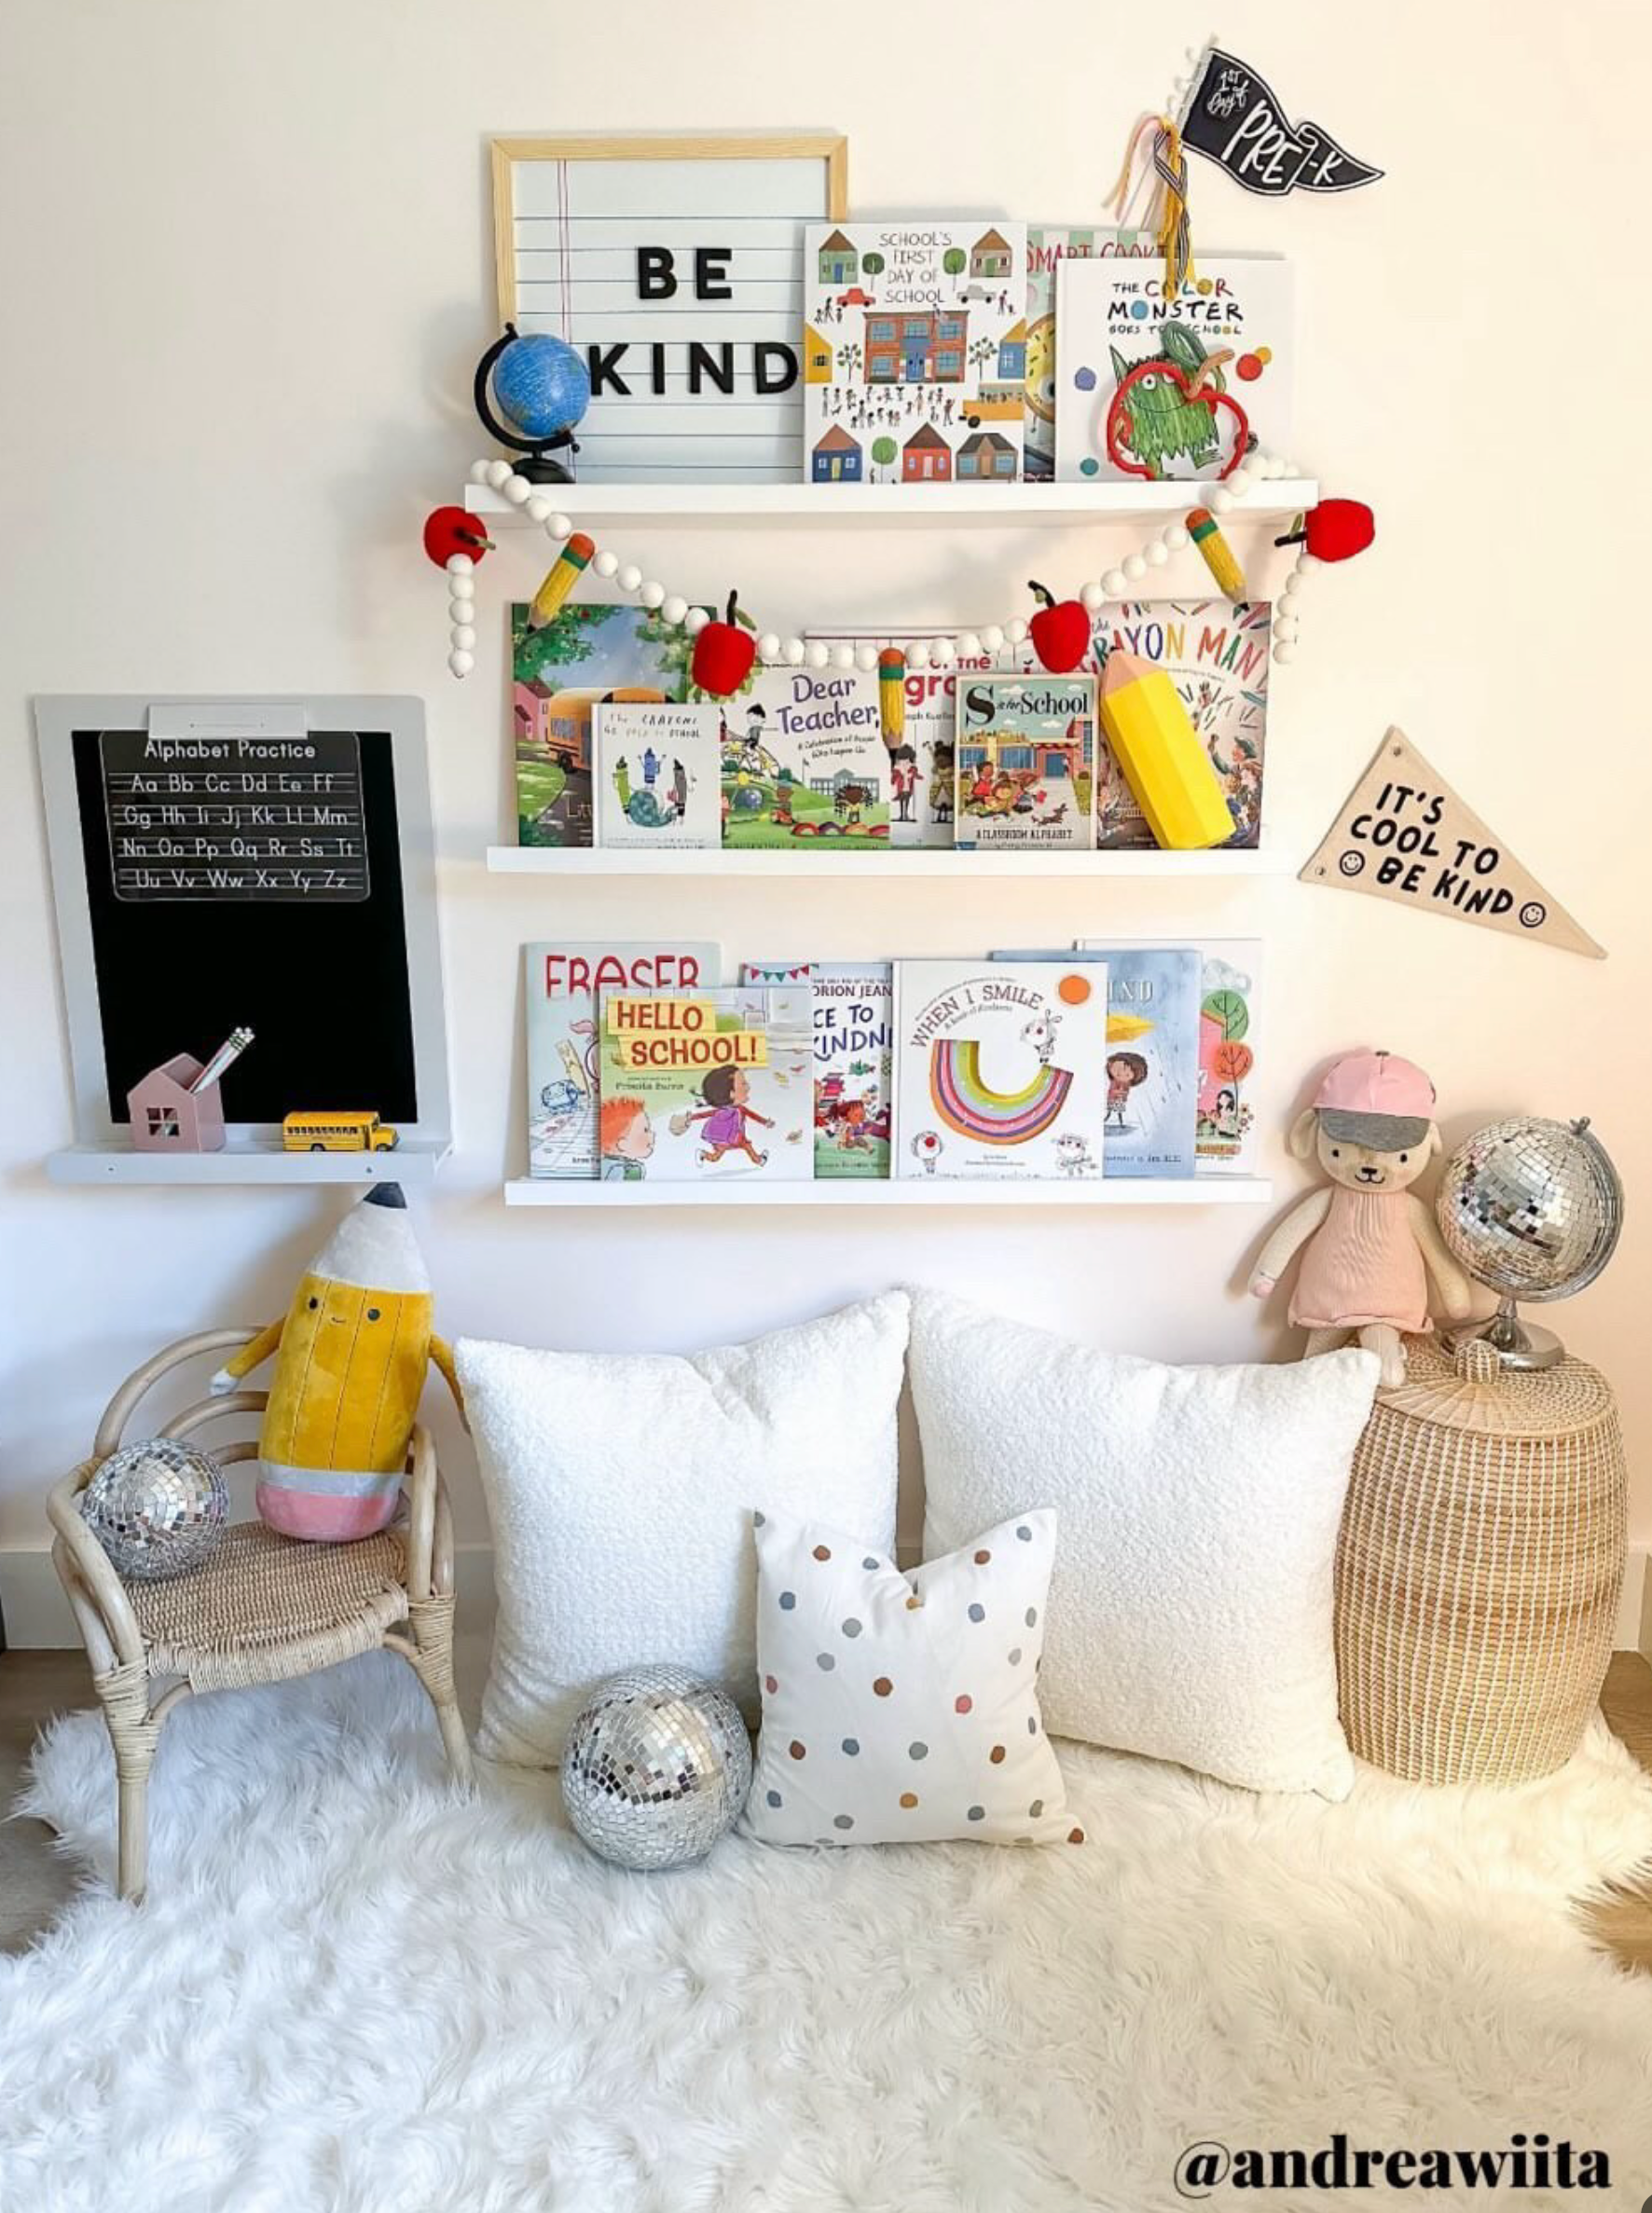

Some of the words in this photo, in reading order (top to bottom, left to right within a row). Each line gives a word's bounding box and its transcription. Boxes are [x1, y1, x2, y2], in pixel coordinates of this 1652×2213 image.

[878, 232, 952, 246] SCHOOL'S
[893, 250, 934, 263] FIRST
[636, 246, 733, 300] BE
[888, 269, 913, 283] DAY
[919, 268, 938, 282] OF
[885, 288, 944, 303] SCHOOL
[1112, 282, 1139, 293] THE
[1145, 279, 1233, 297] CLOR
[1107, 300, 1243, 321] MONSTER
[1109, 325, 1140, 335] GOES
[1189, 325, 1242, 335] CHOOL
[587, 341, 799, 396] KIND
[1198, 625, 1264, 680] MAN
[792, 673, 856, 703] Dear
[966, 684, 996, 727] S
[1021, 692, 1088, 715] School
[776, 701, 880, 735] Teacher,
[145, 740, 229, 763] Alphabet
[238, 740, 316, 758] Practice
[131, 774, 158, 792] Aa
[169, 775, 193, 792] Bb
[205, 775, 230, 792] Cc
[241, 775, 267, 792] Dd
[279, 775, 302, 792] Ee
[314, 774, 334, 792] Ff
[1376, 782, 1445, 825] IT'S
[124, 806, 152, 829] Gg
[161, 807, 186, 824] Hh
[198, 807, 209, 824] Ii
[221, 807, 241, 829] Jj
[252, 807, 275, 824] Kk
[286, 807, 302, 824] Ll
[313, 807, 348, 824] Mm
[123, 839, 146, 856] Nn
[158, 839, 185, 856] Oo
[195, 839, 218, 860] Pp
[230, 839, 258, 860] Qq
[268, 839, 288, 856] Rr
[300, 839, 324, 856] Ss
[336, 839, 352, 856] Tt
[1351, 814, 1439, 857] COOL
[1453, 840, 1499, 874] TO
[135, 870, 159, 887] Uu
[172, 870, 195, 887] Vv
[206, 870, 243, 887] Ww
[255, 870, 278, 887] Xx
[290, 870, 310, 893] Yy
[323, 870, 347, 887] Zz
[1377, 857, 1426, 893] BE
[1432, 869, 1513, 914] KIND
[860, 984, 892, 998] JEAN
[1108, 981, 1154, 1003] IND
[616, 1000, 704, 1032] HELLO
[814, 1008, 836, 1028] CE
[847, 1004, 874, 1024] TO
[911, 996, 960, 1048] WHEN
[966, 988, 974, 1004] I
[983, 984, 1044, 1010] SMILE
[630, 1035, 757, 1066] SCHOOL!
